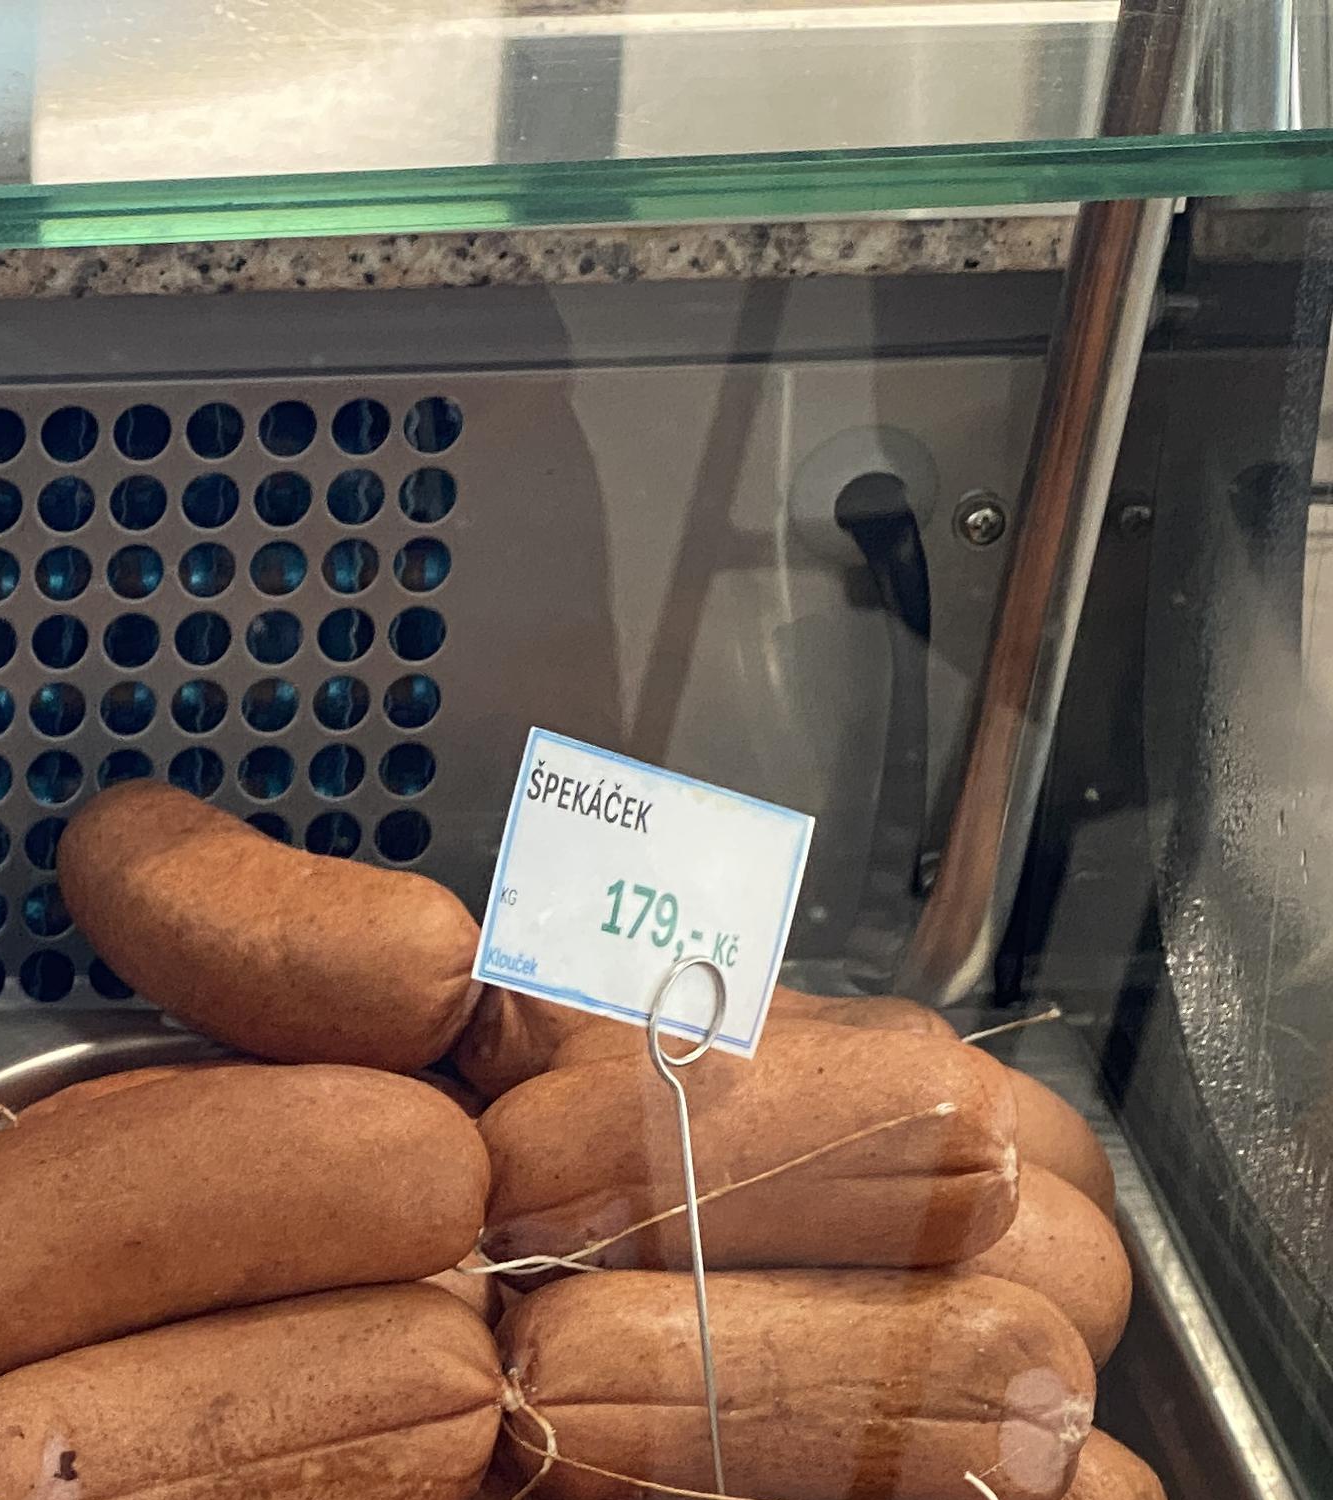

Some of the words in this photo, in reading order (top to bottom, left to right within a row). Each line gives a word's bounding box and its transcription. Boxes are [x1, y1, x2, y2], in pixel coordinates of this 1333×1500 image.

[526, 759, 655, 834] ŠPEKÁČEK
[500, 886, 518, 906] KG
[600, 878, 703, 961] 179,-
[711, 932, 740, 968] Kč
[486, 945, 539, 977] Klouček
